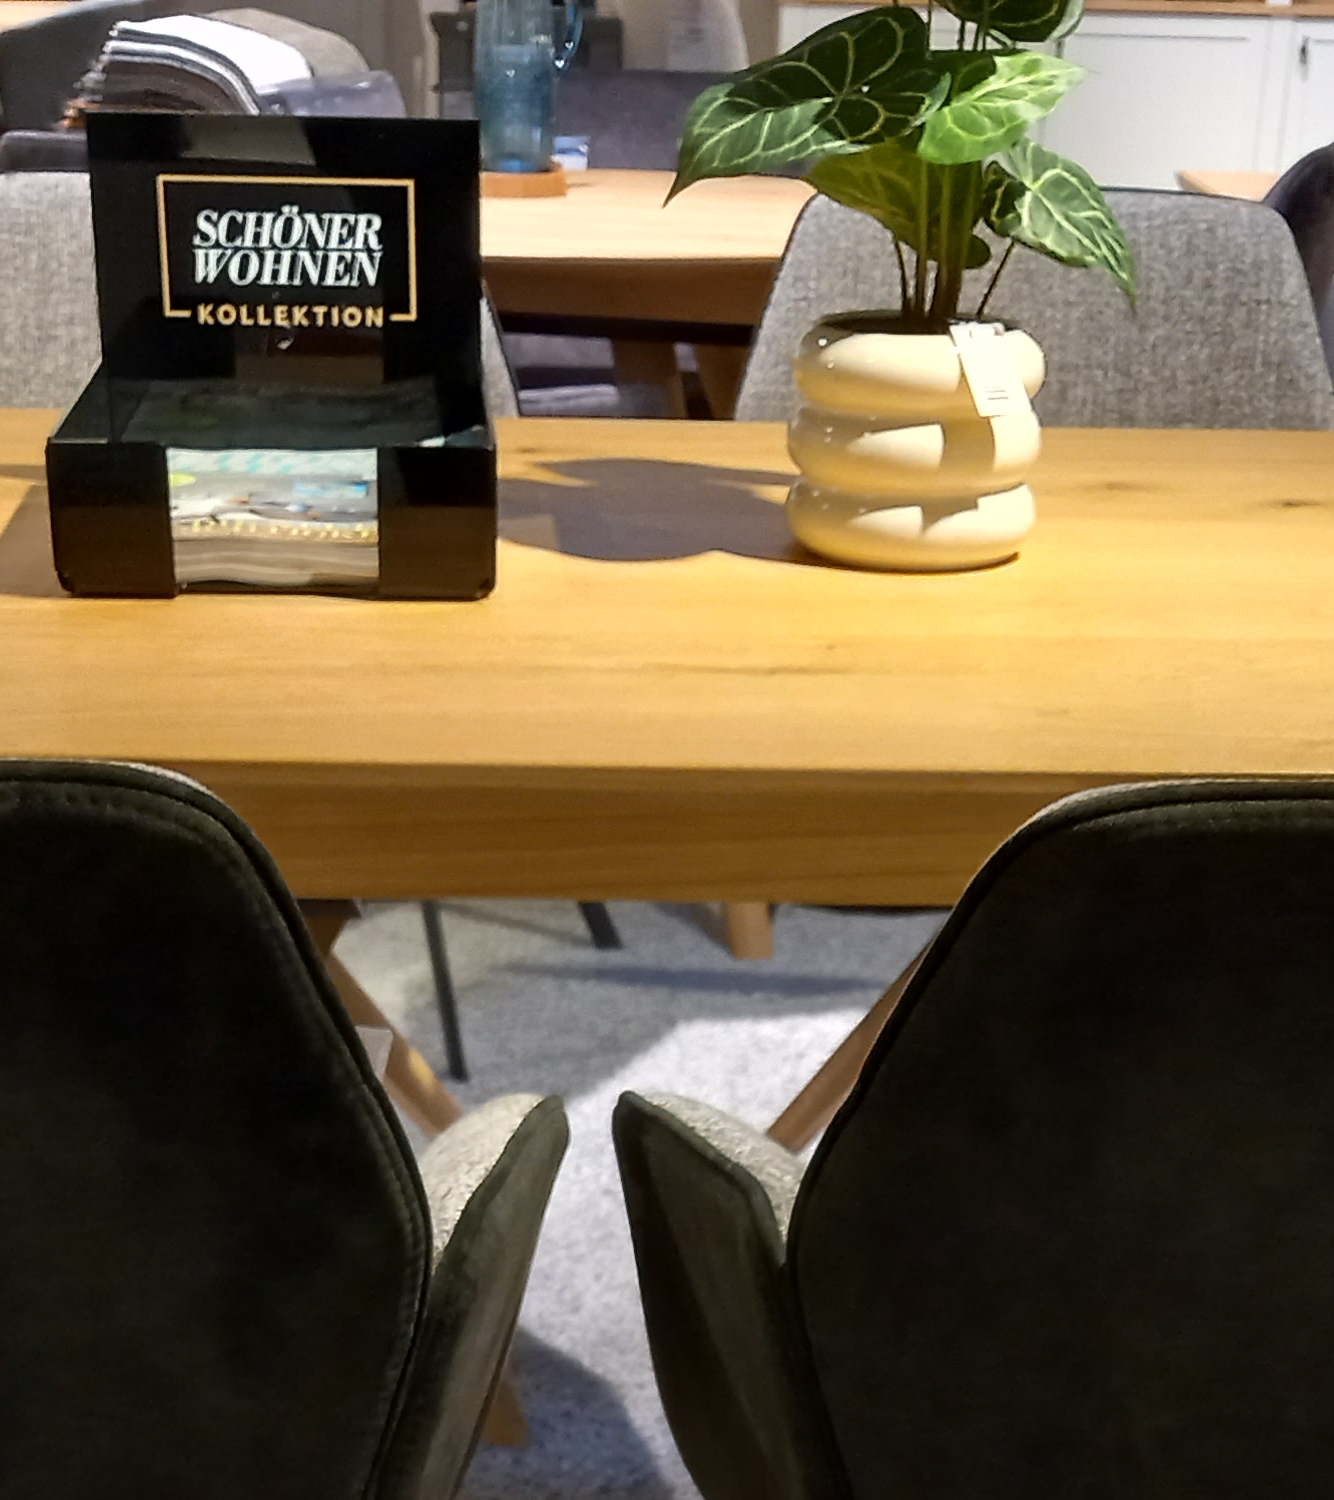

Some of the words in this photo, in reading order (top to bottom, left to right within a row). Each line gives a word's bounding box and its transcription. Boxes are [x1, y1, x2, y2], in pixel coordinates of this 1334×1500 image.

[192, 204, 383, 250] SCHÖNER
[193, 248, 383, 287] WOHNEN
[196, 303, 384, 328] KOLLEKTION
